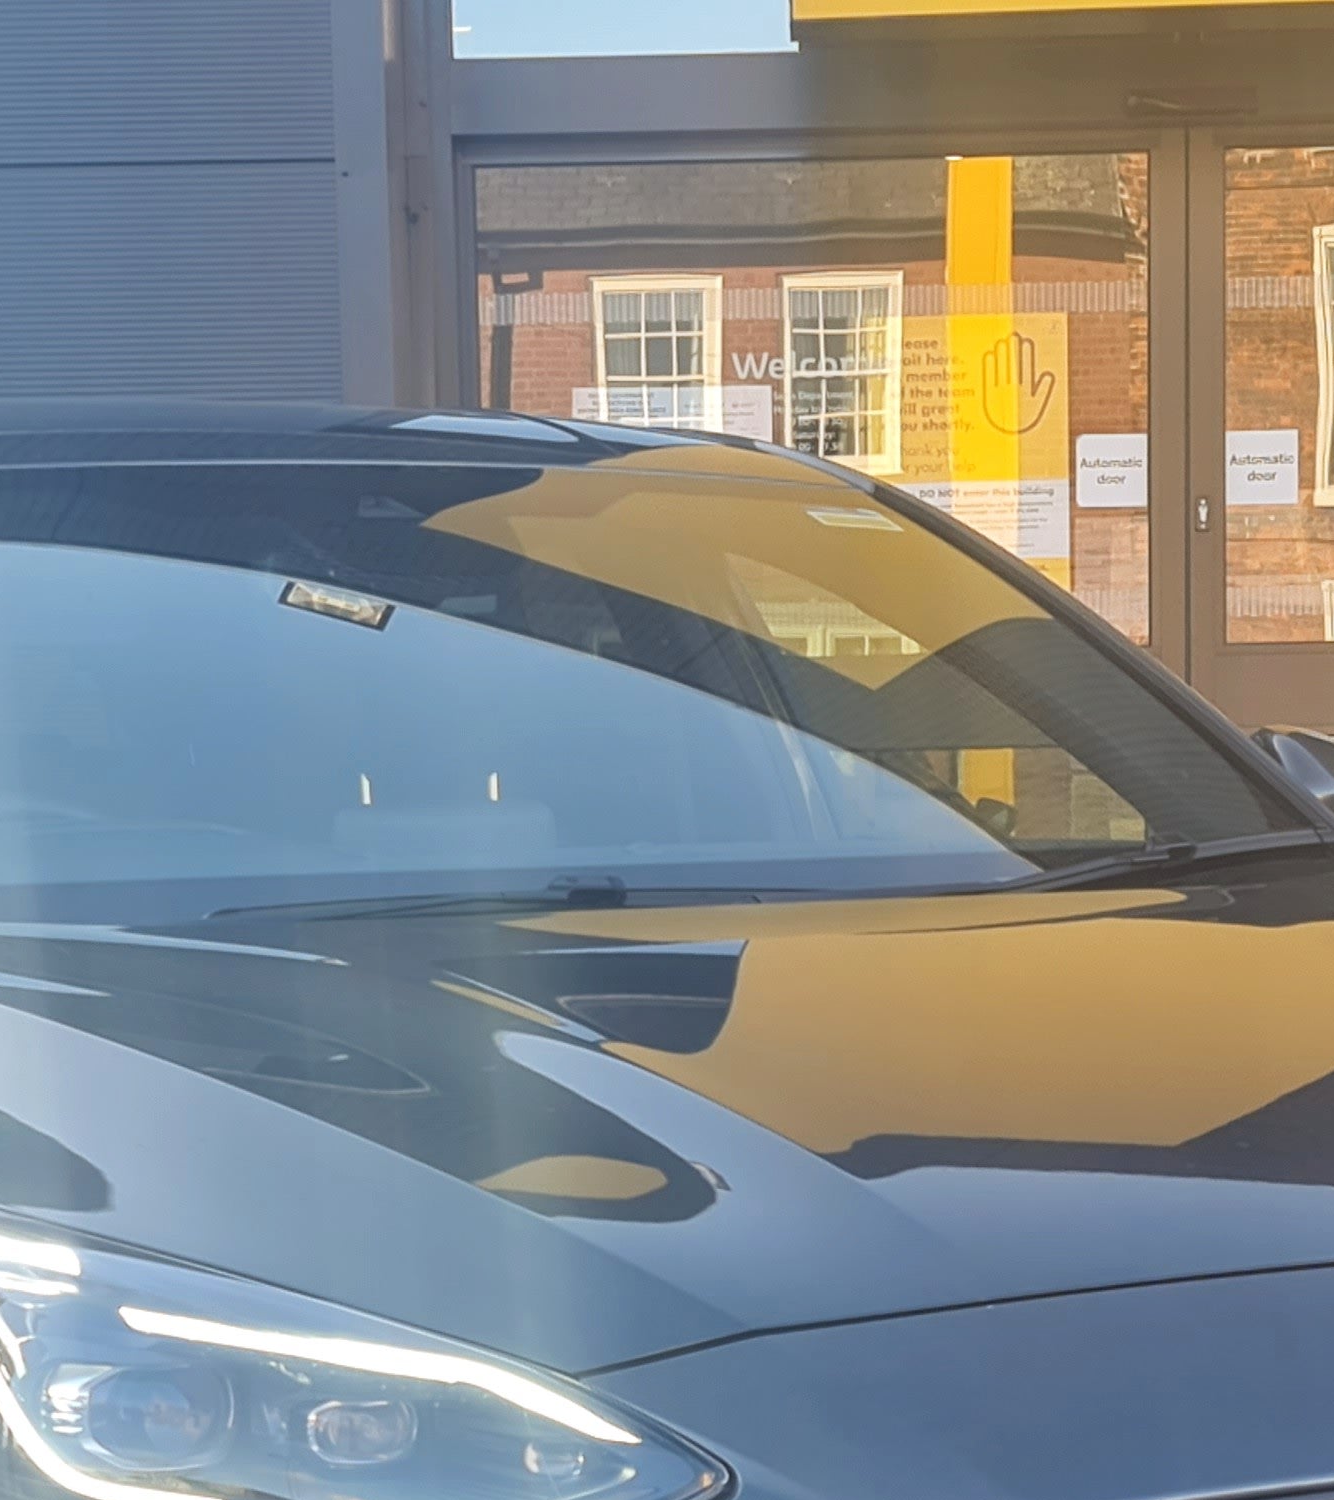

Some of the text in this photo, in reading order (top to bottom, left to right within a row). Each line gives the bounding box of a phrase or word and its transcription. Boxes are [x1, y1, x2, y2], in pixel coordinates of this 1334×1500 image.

[1080, 456, 1143, 469] Automatic
[1230, 453, 1295, 466] Automatic
[1097, 474, 1126, 484] door
[1247, 470, 1276, 481] door
